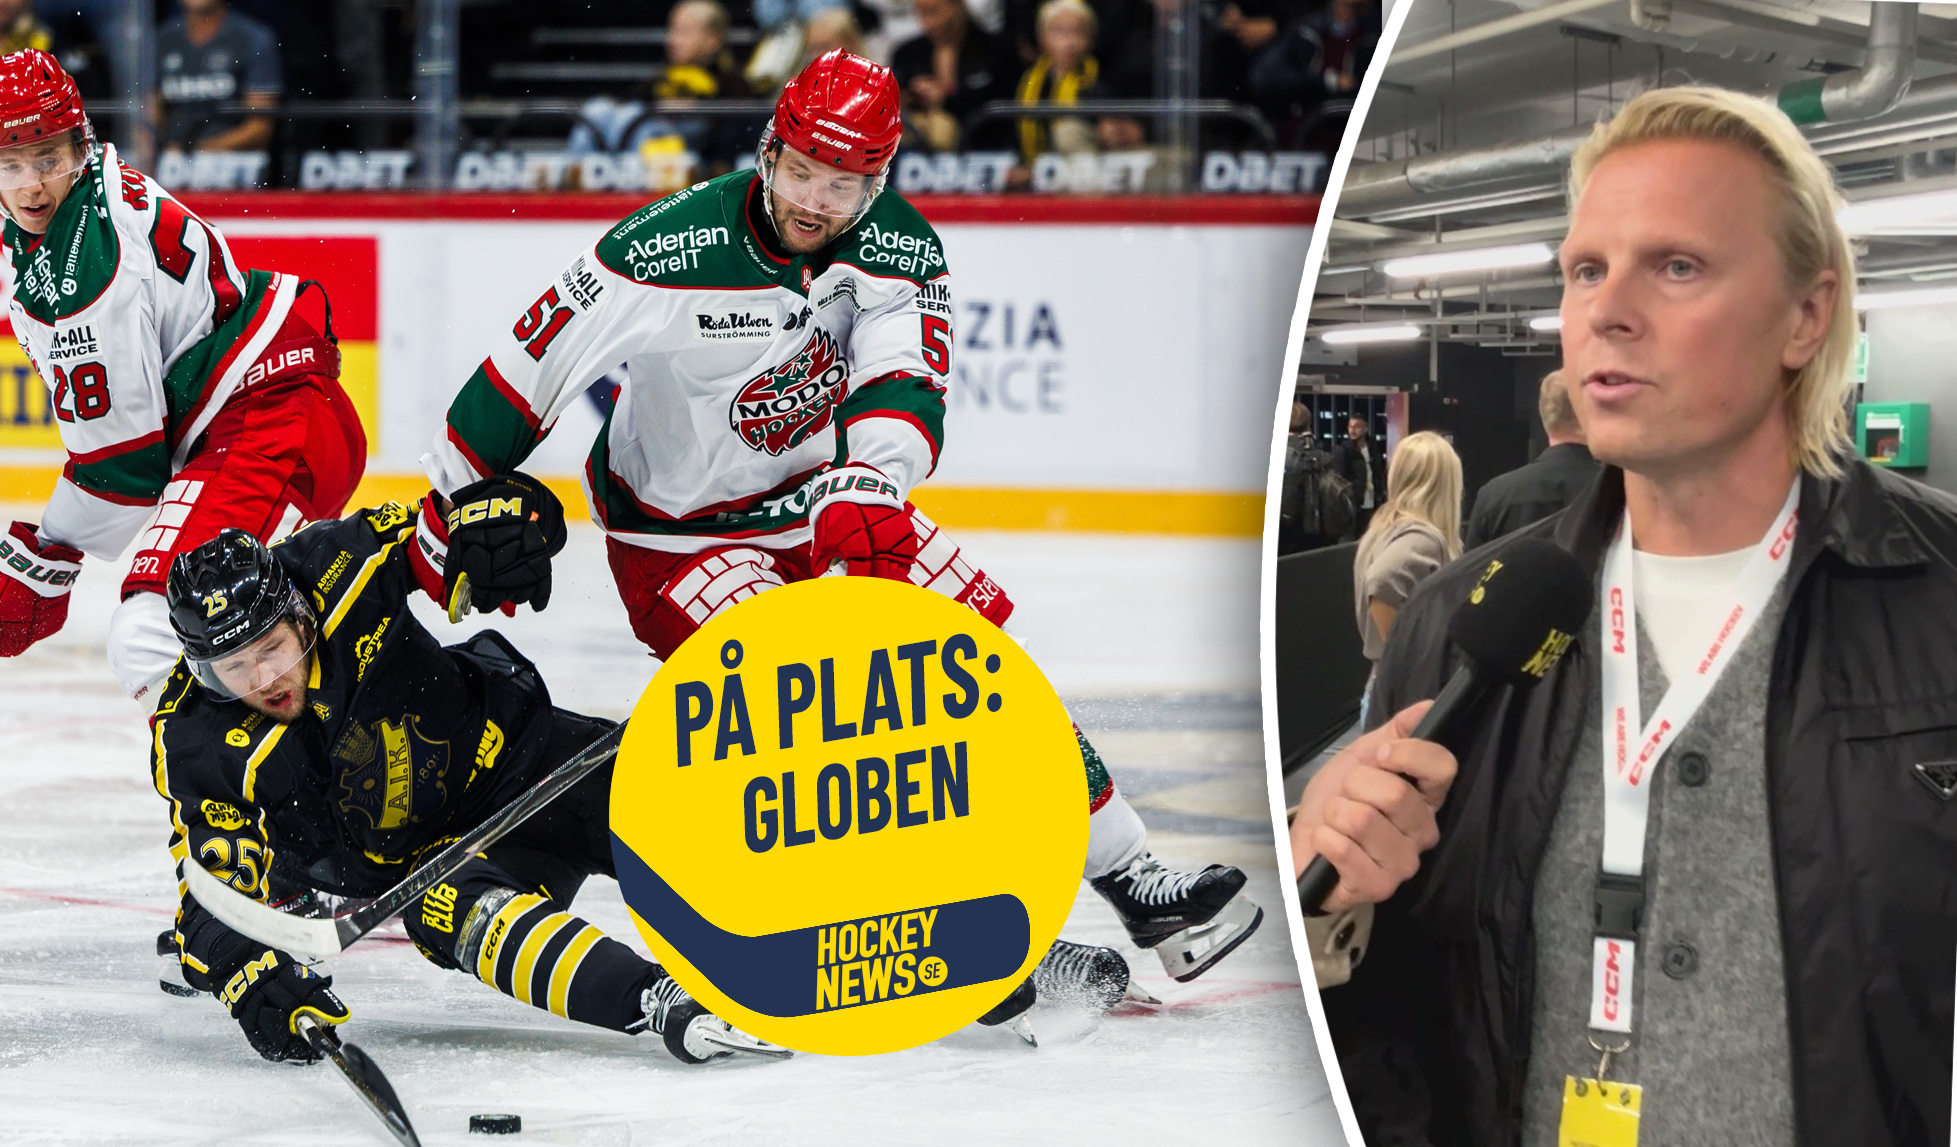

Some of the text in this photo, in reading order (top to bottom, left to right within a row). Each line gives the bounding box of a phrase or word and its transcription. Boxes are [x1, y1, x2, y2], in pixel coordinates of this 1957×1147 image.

[3, 113, 41, 129] BAUER
[1203, 151, 1327, 192] DBET
[624, 225, 729, 263] Aderian
[633, 248, 703, 282] CoreIT
[859, 222, 944, 267] Aderia
[859, 244, 932, 276] CoreIT
[513, 284, 577, 363] 51
[700, 330, 771, 339] SURSTRÖMMING
[920, 312, 954, 377] 5
[963, 301, 1064, 350] ZIA
[50, 343, 99, 359] ERVICE
[53, 361, 112, 423] 28
[737, 364, 845, 418] MODO
[750, 385, 841, 444] HOCKEY
[810, 475, 900, 507] AUER
[1768, 507, 1799, 561] CC
[317, 550, 347, 590] ADVANZIA
[322, 552, 354, 594] INSURANCE
[202, 590, 228, 617] 25
[1610, 587, 1626, 654] CCM
[212, 619, 250, 646] CCM
[357, 617, 391, 682] INDUSTREA
[1629, 719, 1672, 787] CCM
[200, 836, 262, 896] 25
[436, 883, 458, 934] CLUB
[485, 917, 506, 960] CCM
[1604, 938, 1621, 1022] CCM
